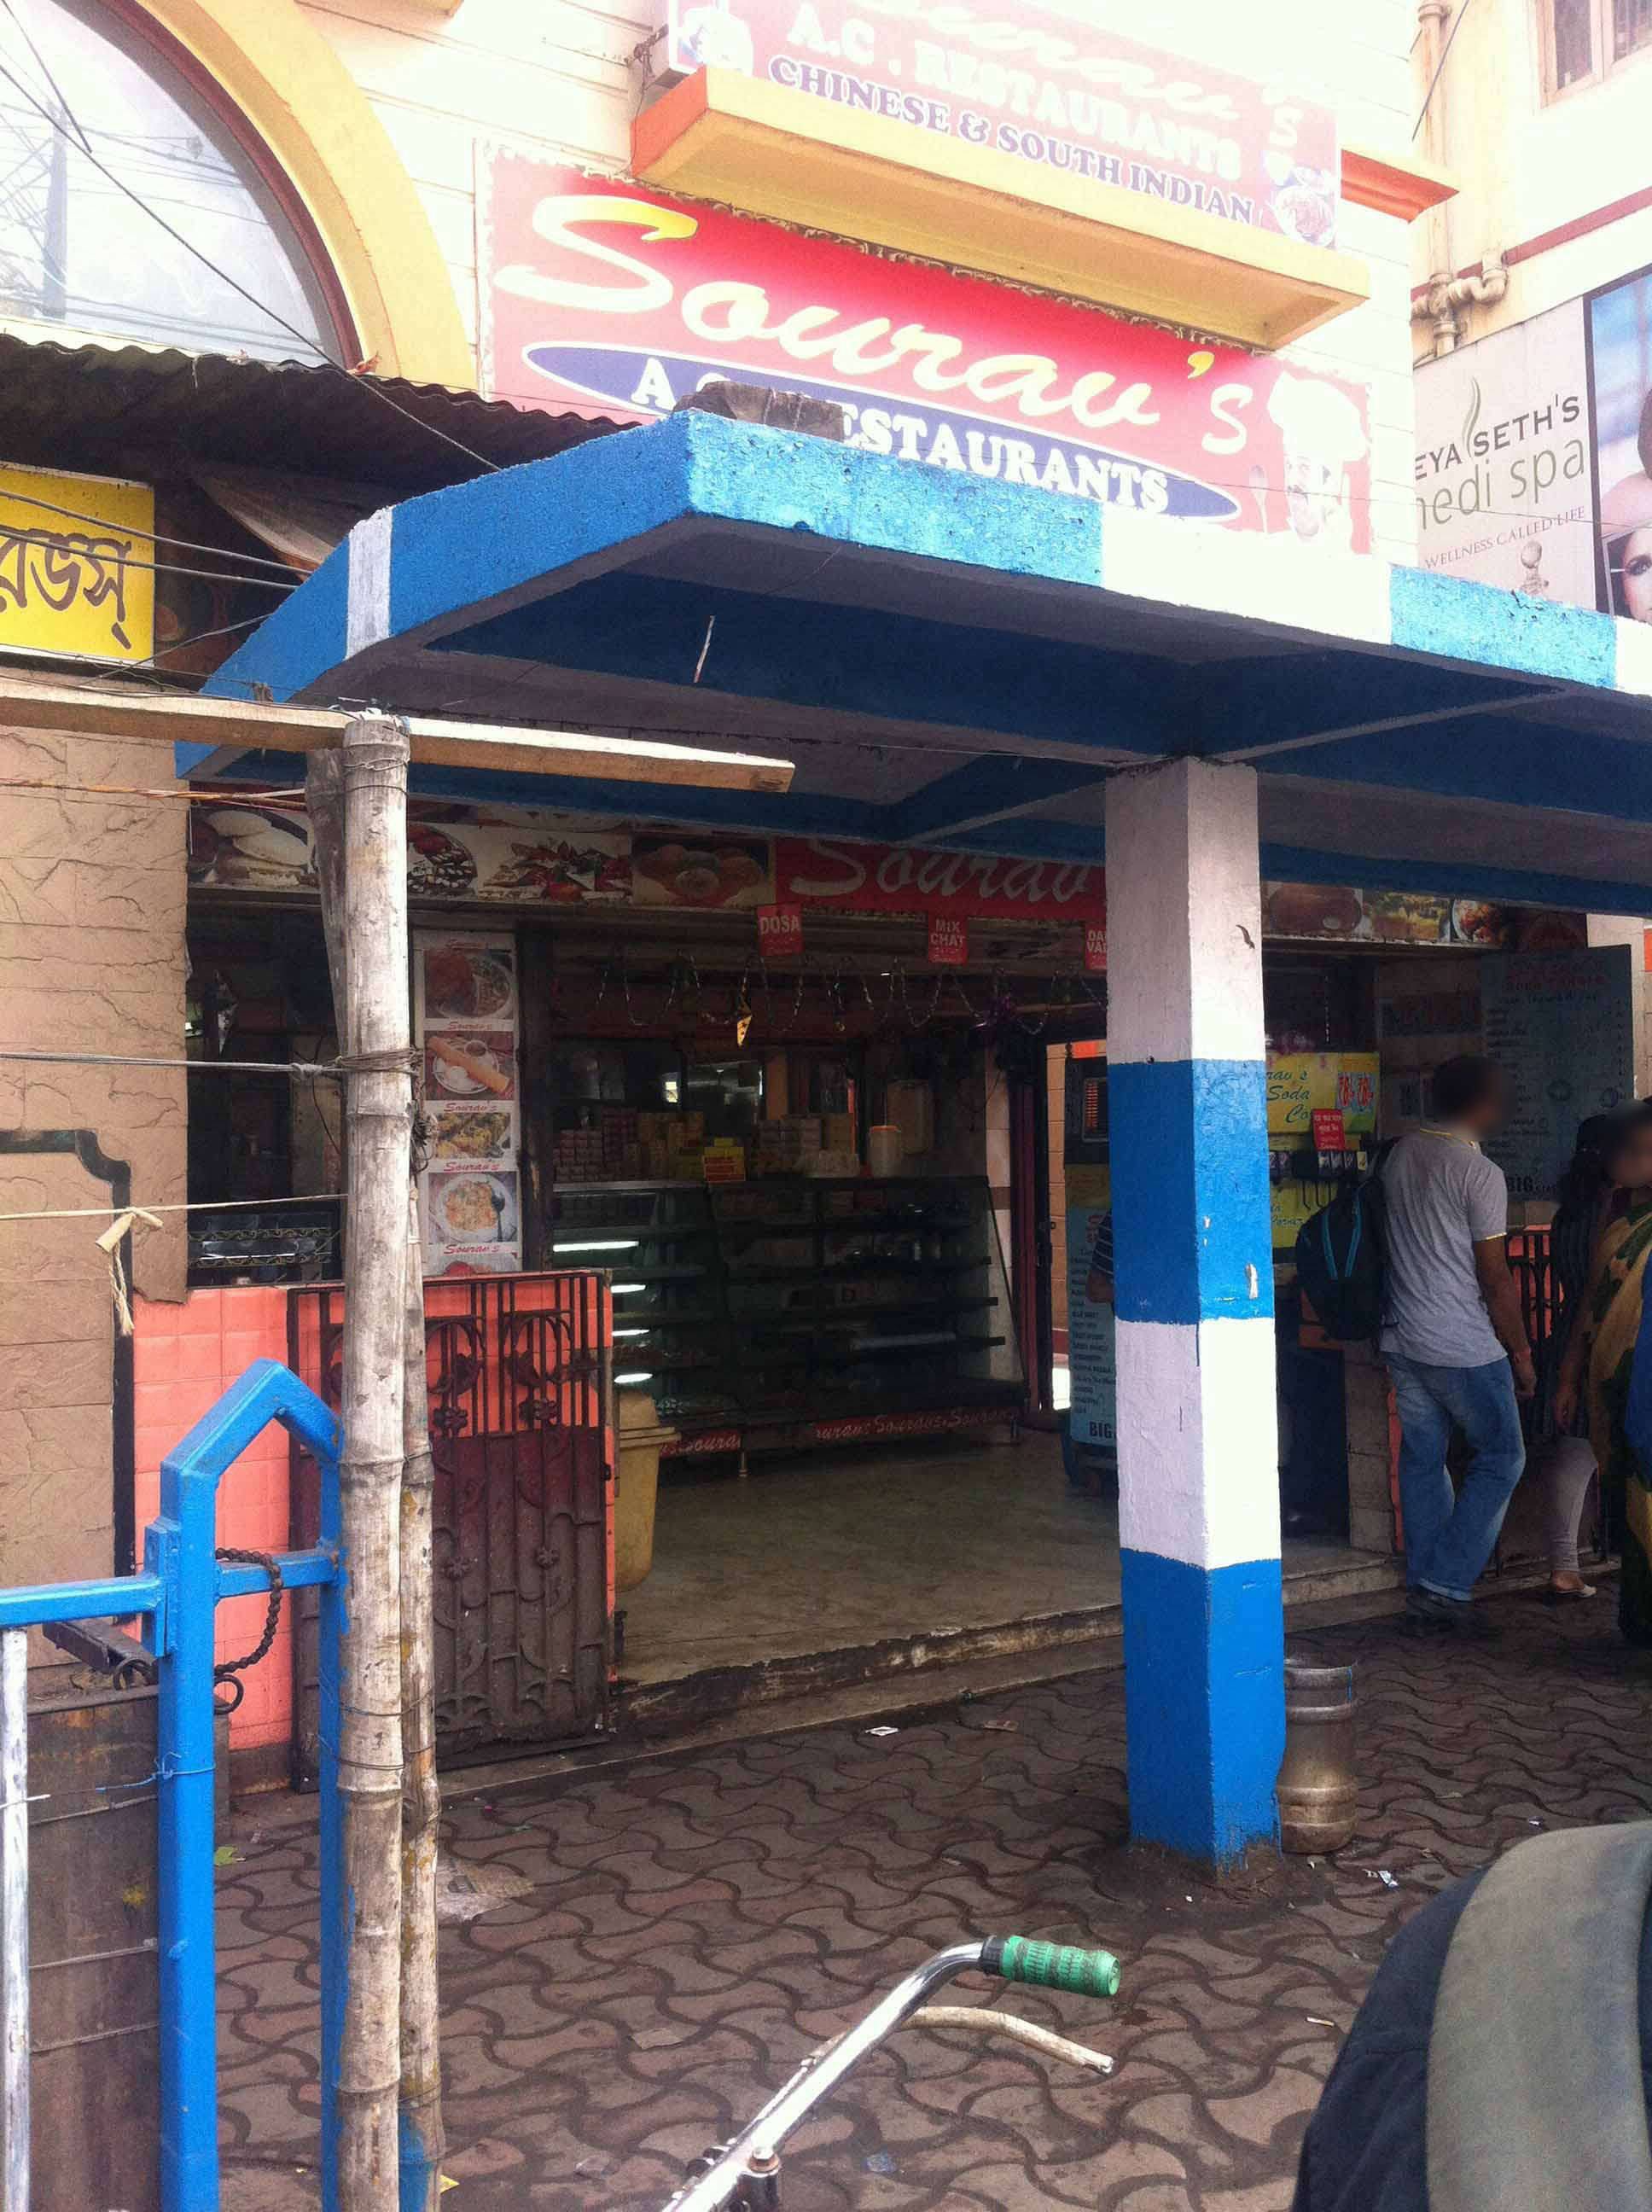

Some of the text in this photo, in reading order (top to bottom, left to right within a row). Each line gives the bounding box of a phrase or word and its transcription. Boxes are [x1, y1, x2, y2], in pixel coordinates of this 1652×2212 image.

[770, 55, 1254, 225] CHINESE & SOUTH INDIAN
[495, 195, 1248, 455] Sourav's
[1474, 393, 1581, 457] SETH'S
[842, 404, 1168, 512] STAURANTS
[1510, 439, 1585, 504] spa
[1425, 538, 1494, 569] WELLNESS
[1497, 517, 1552, 546] CALLED
[759, 916, 800, 935] DOSA
[1089, 1421, 1113, 1439] BIG
